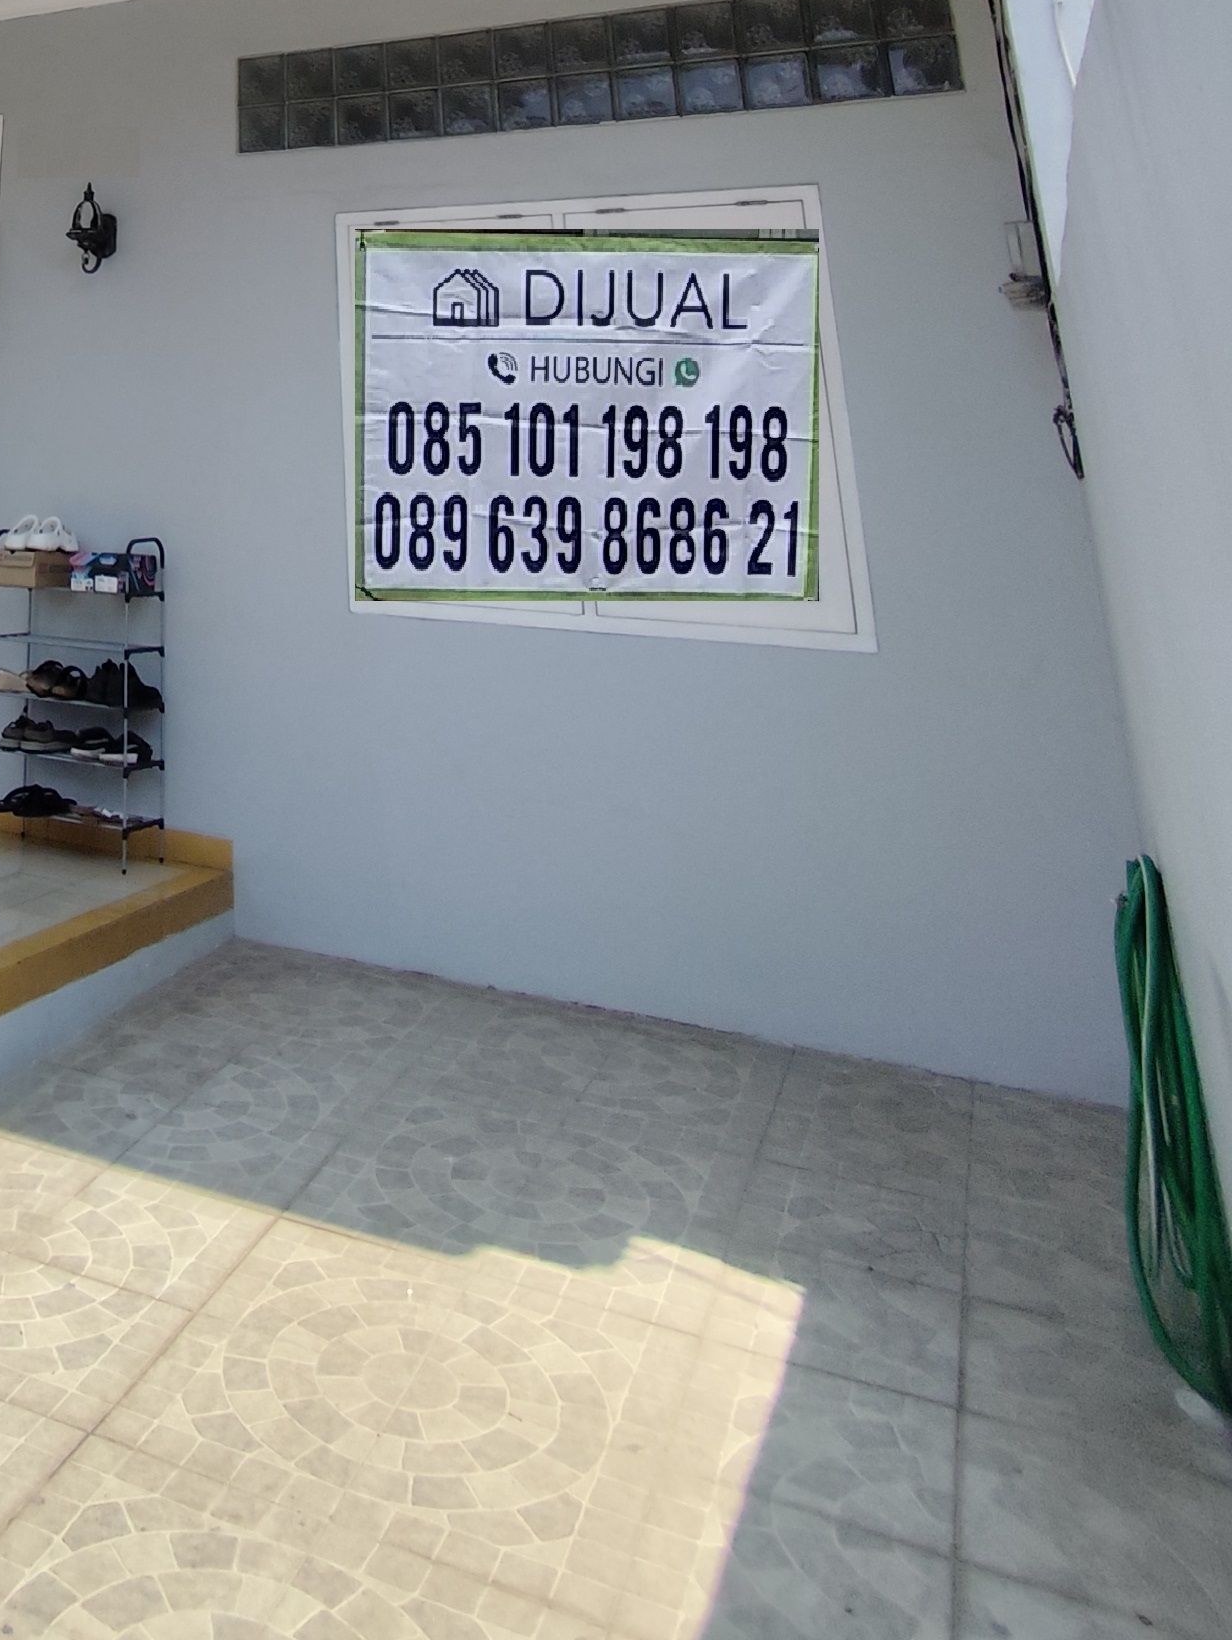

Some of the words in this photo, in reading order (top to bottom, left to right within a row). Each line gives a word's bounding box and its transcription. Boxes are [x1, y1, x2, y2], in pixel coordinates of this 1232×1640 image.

[524, 269, 748, 330] DIJUAL
[530, 355, 664, 388] HUBUNGI
[388, 401, 482, 477] 085
[503, 402, 579, 478] 101
[601, 404, 684, 479] 198
[704, 404, 788, 483] 198
[375, 491, 468, 572] 089
[488, 494, 582, 575] 639
[602, 497, 730, 576] 8686
[746, 499, 799, 578] 21
